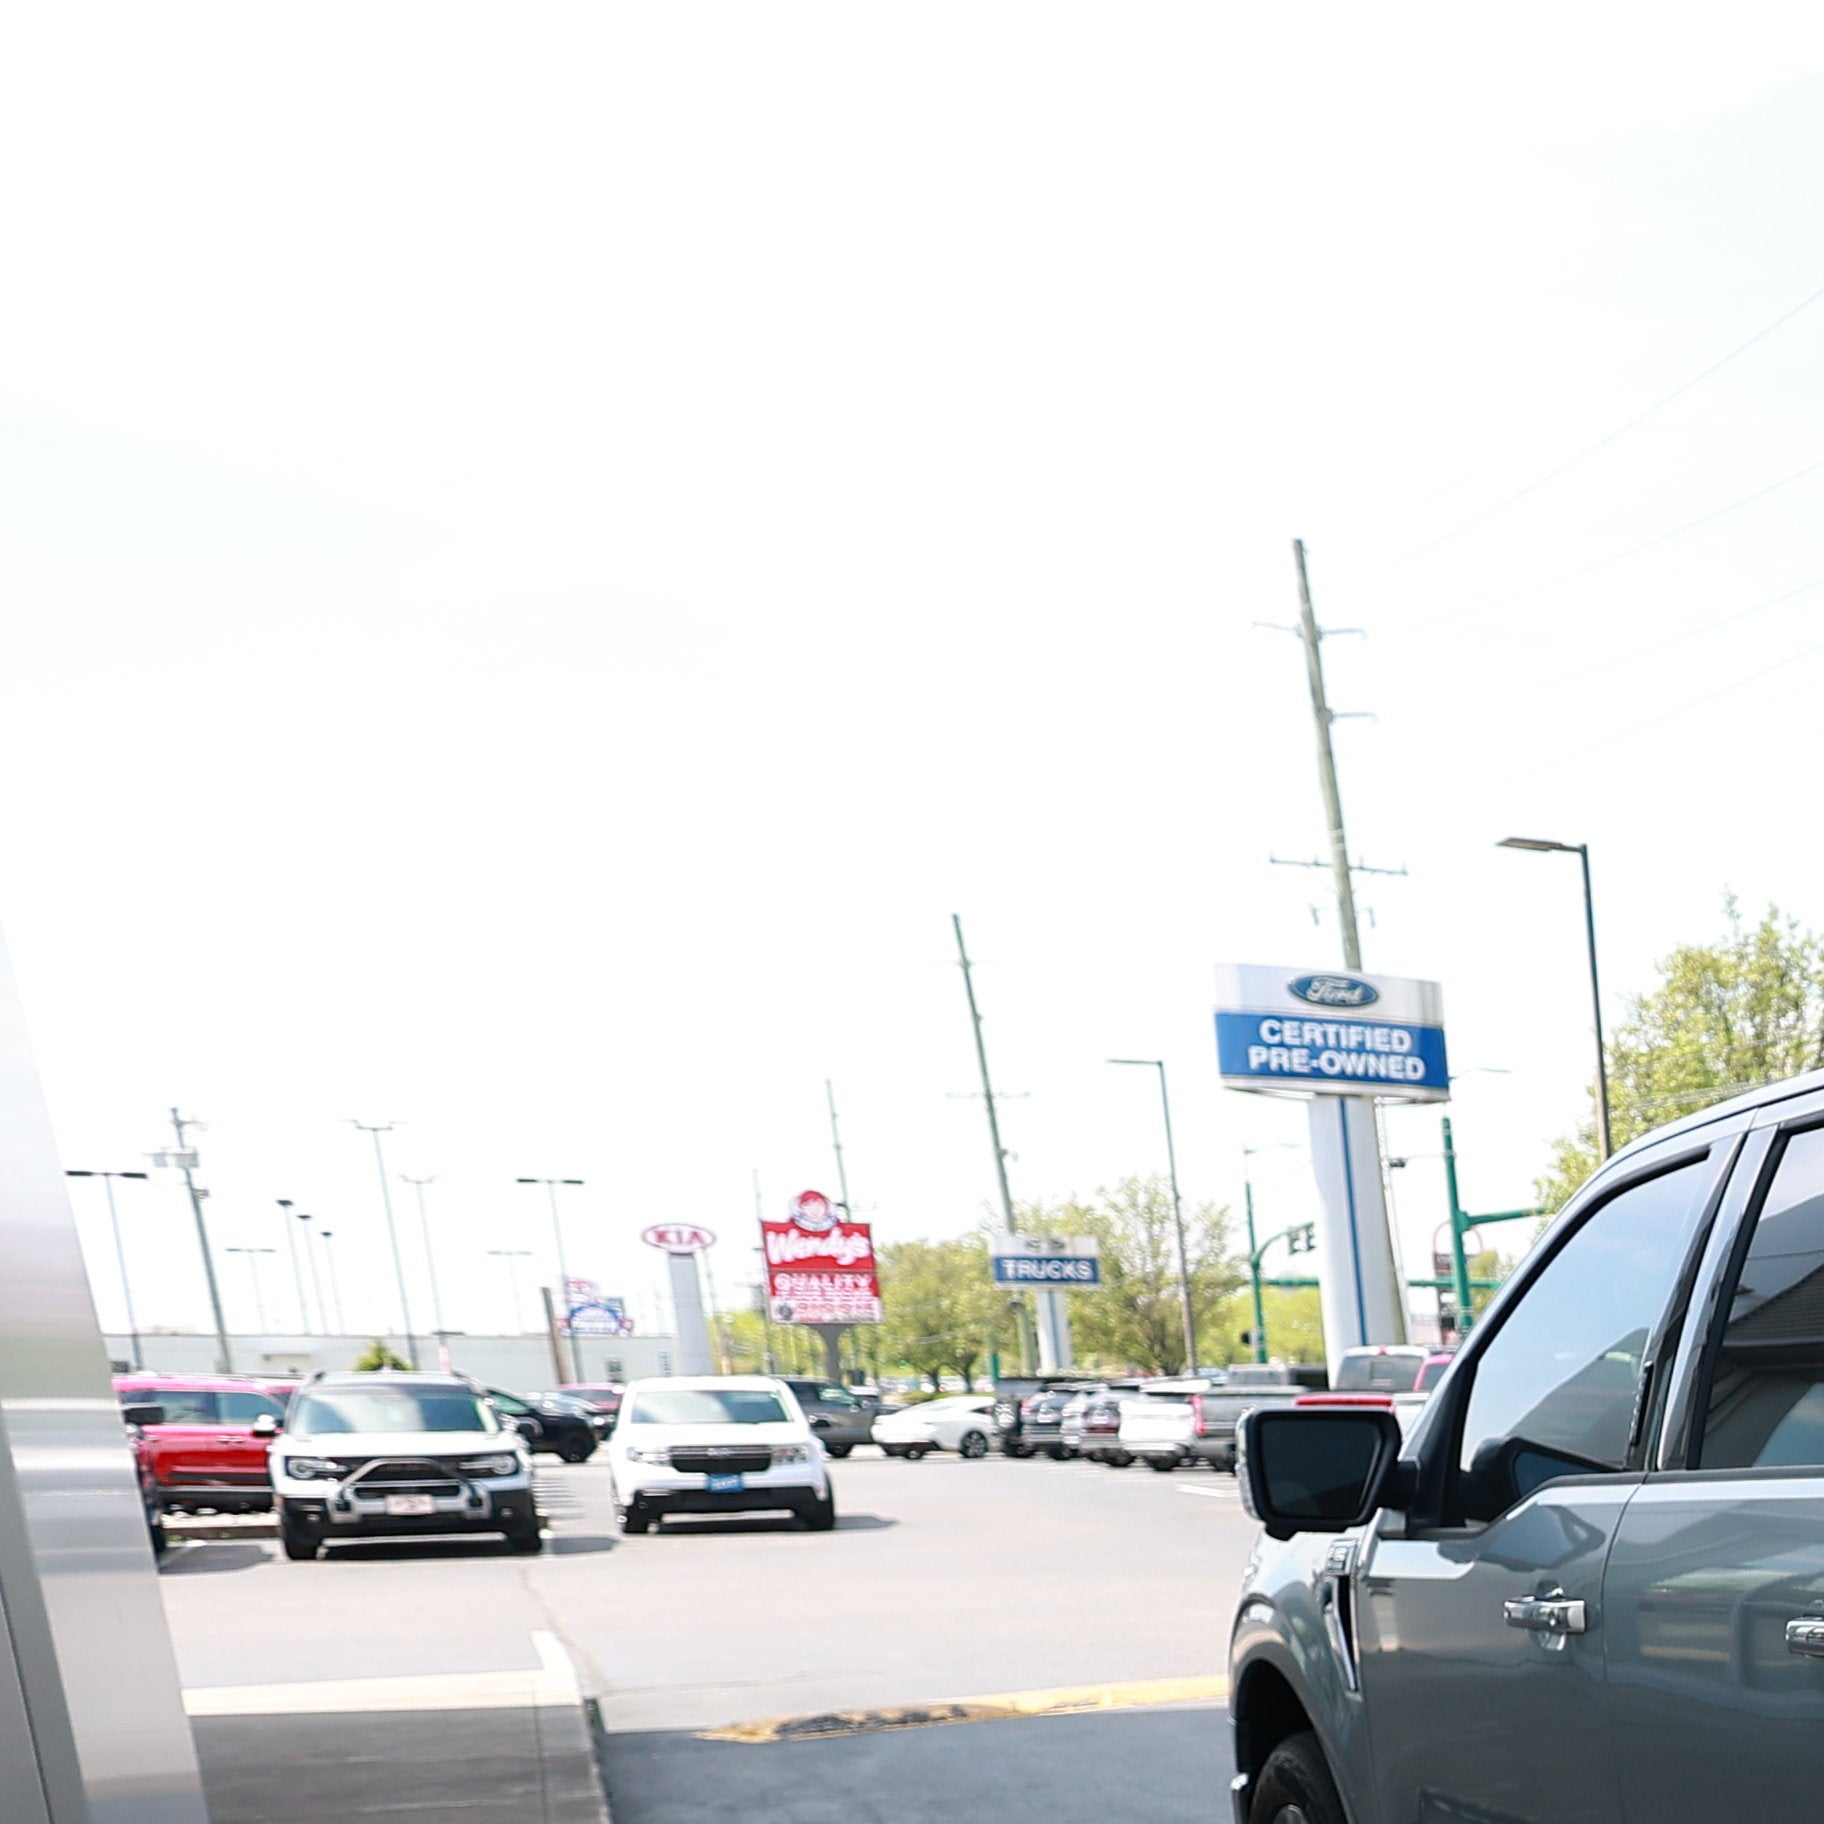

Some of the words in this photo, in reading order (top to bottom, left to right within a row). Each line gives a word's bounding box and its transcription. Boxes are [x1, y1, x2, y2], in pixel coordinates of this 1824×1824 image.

[1306, 976, 1364, 1004] Ford
[1259, 1018, 1413, 1053] CERTIFIED
[1247, 1045, 1426, 1081] PRE-OWNED
[654, 1230, 706, 1245] KIA
[1001, 1259, 1093, 1280] TRUCKS
